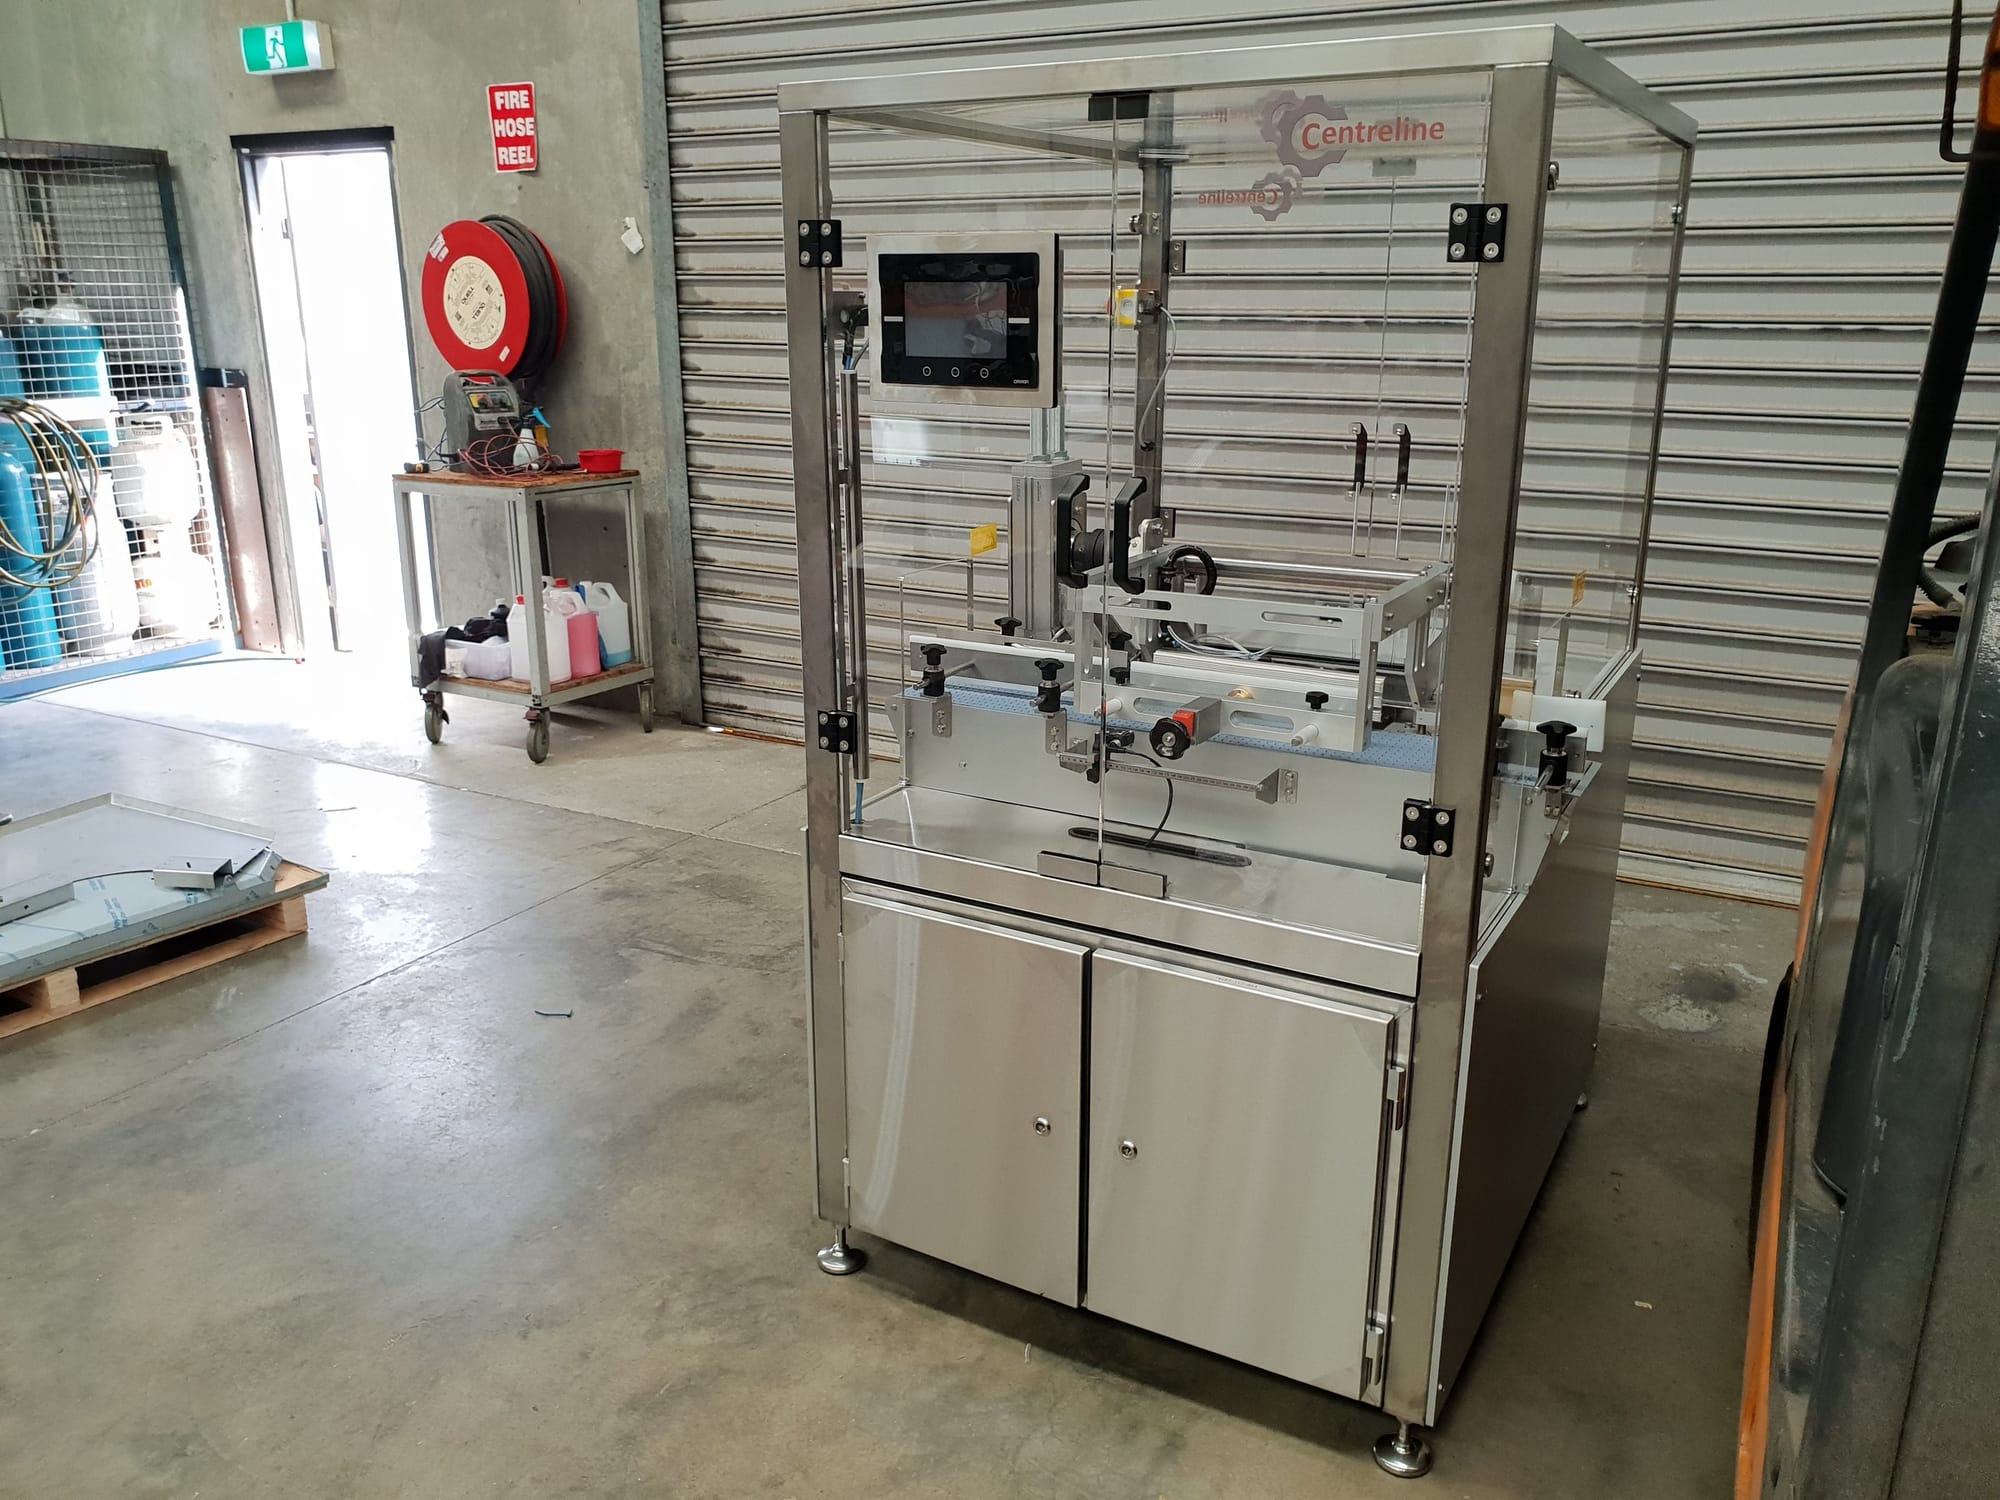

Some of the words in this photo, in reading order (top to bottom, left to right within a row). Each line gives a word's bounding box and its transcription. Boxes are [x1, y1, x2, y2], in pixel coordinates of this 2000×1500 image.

[494, 90, 530, 110] FIRE
[494, 117, 535, 138] HOSE
[1302, 117, 1445, 150] Centreline
[498, 146, 534, 165] REEL
